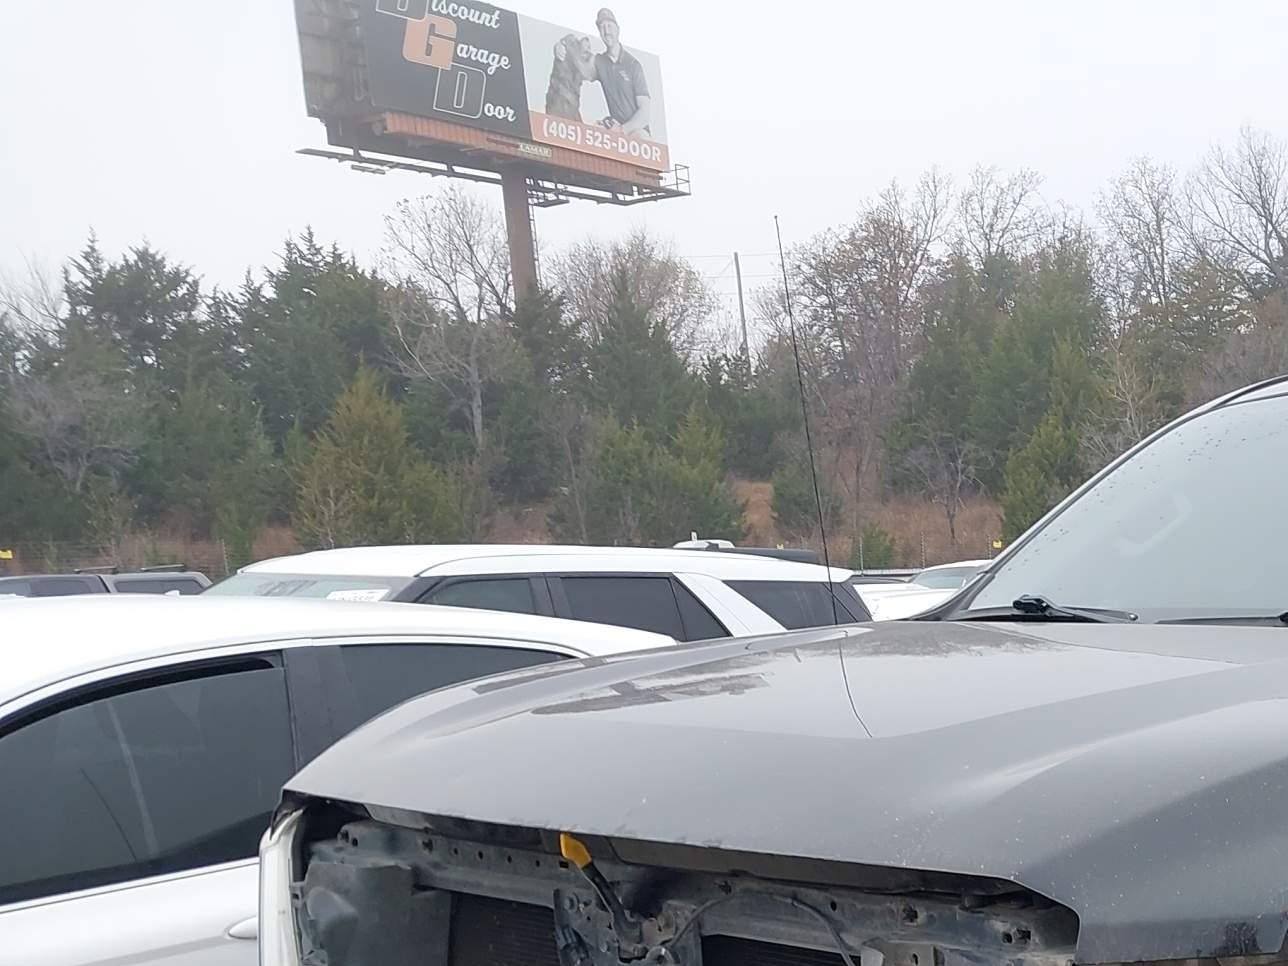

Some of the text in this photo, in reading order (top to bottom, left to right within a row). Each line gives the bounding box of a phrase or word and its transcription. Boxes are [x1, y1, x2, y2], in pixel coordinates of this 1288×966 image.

[402, 14, 512, 75] Garage
[433, 62, 516, 122] Door
[543, 119, 662, 162] (405) 525-DOOR
